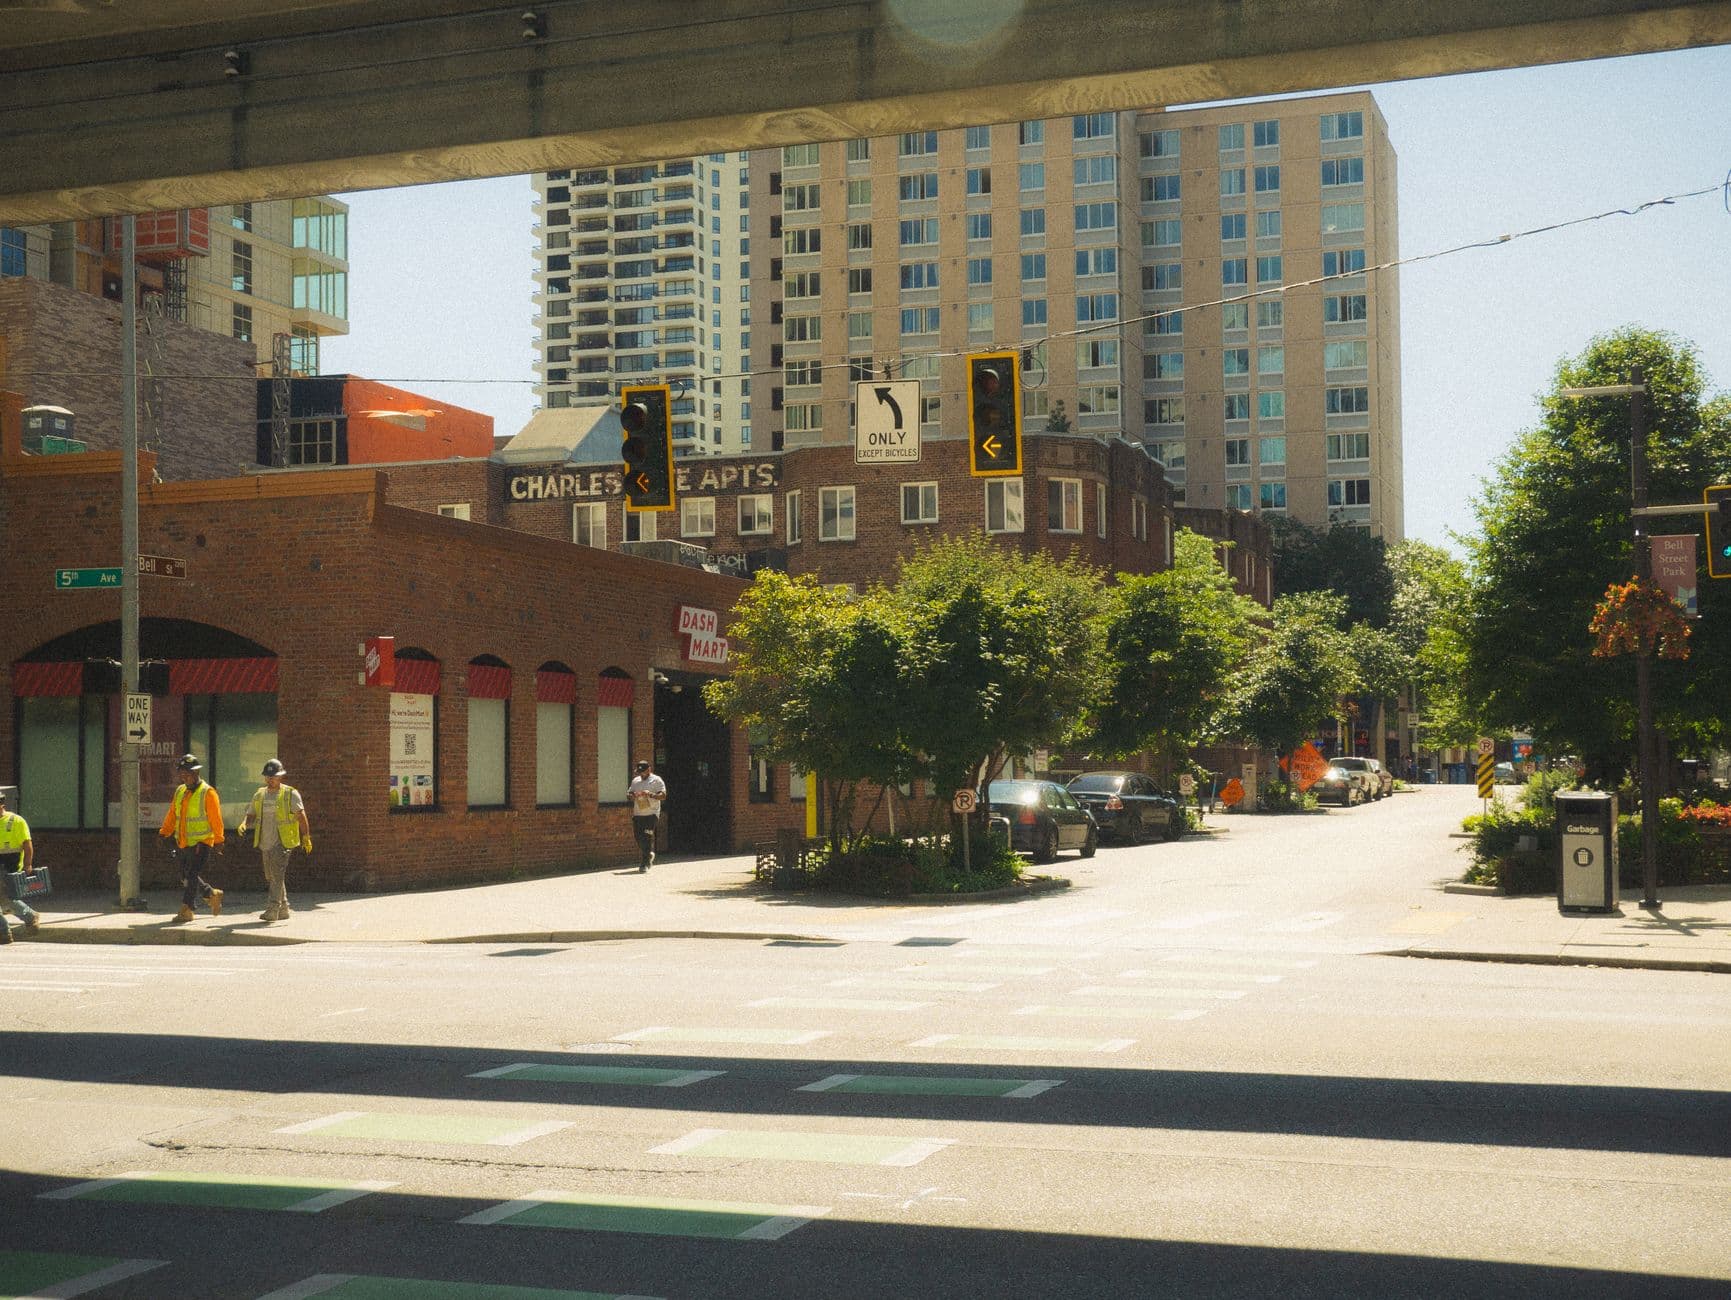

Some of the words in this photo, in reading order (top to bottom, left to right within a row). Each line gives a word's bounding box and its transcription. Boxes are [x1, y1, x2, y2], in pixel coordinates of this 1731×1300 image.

[869, 432, 907, 446] ONLY
[859, 449, 883, 458] EXCEPT
[886, 448, 918, 457] BICYCLES
[700, 464, 779, 489] APTS.
[1664, 540, 1684, 550] Bell
[1659, 553, 1689, 563] Street
[139, 557, 156, 572] Bell
[165, 564, 173, 574] St
[1663, 567, 1686, 576] Park
[62, 571, 79, 586] 5th
[100, 573, 117, 583] Ave
[682, 611, 715, 633] DASH
[693, 639, 726, 660] MART
[128, 698, 148, 710] ONE
[128, 712, 148, 724] WAY
[1567, 825, 1599, 835] Garbage
